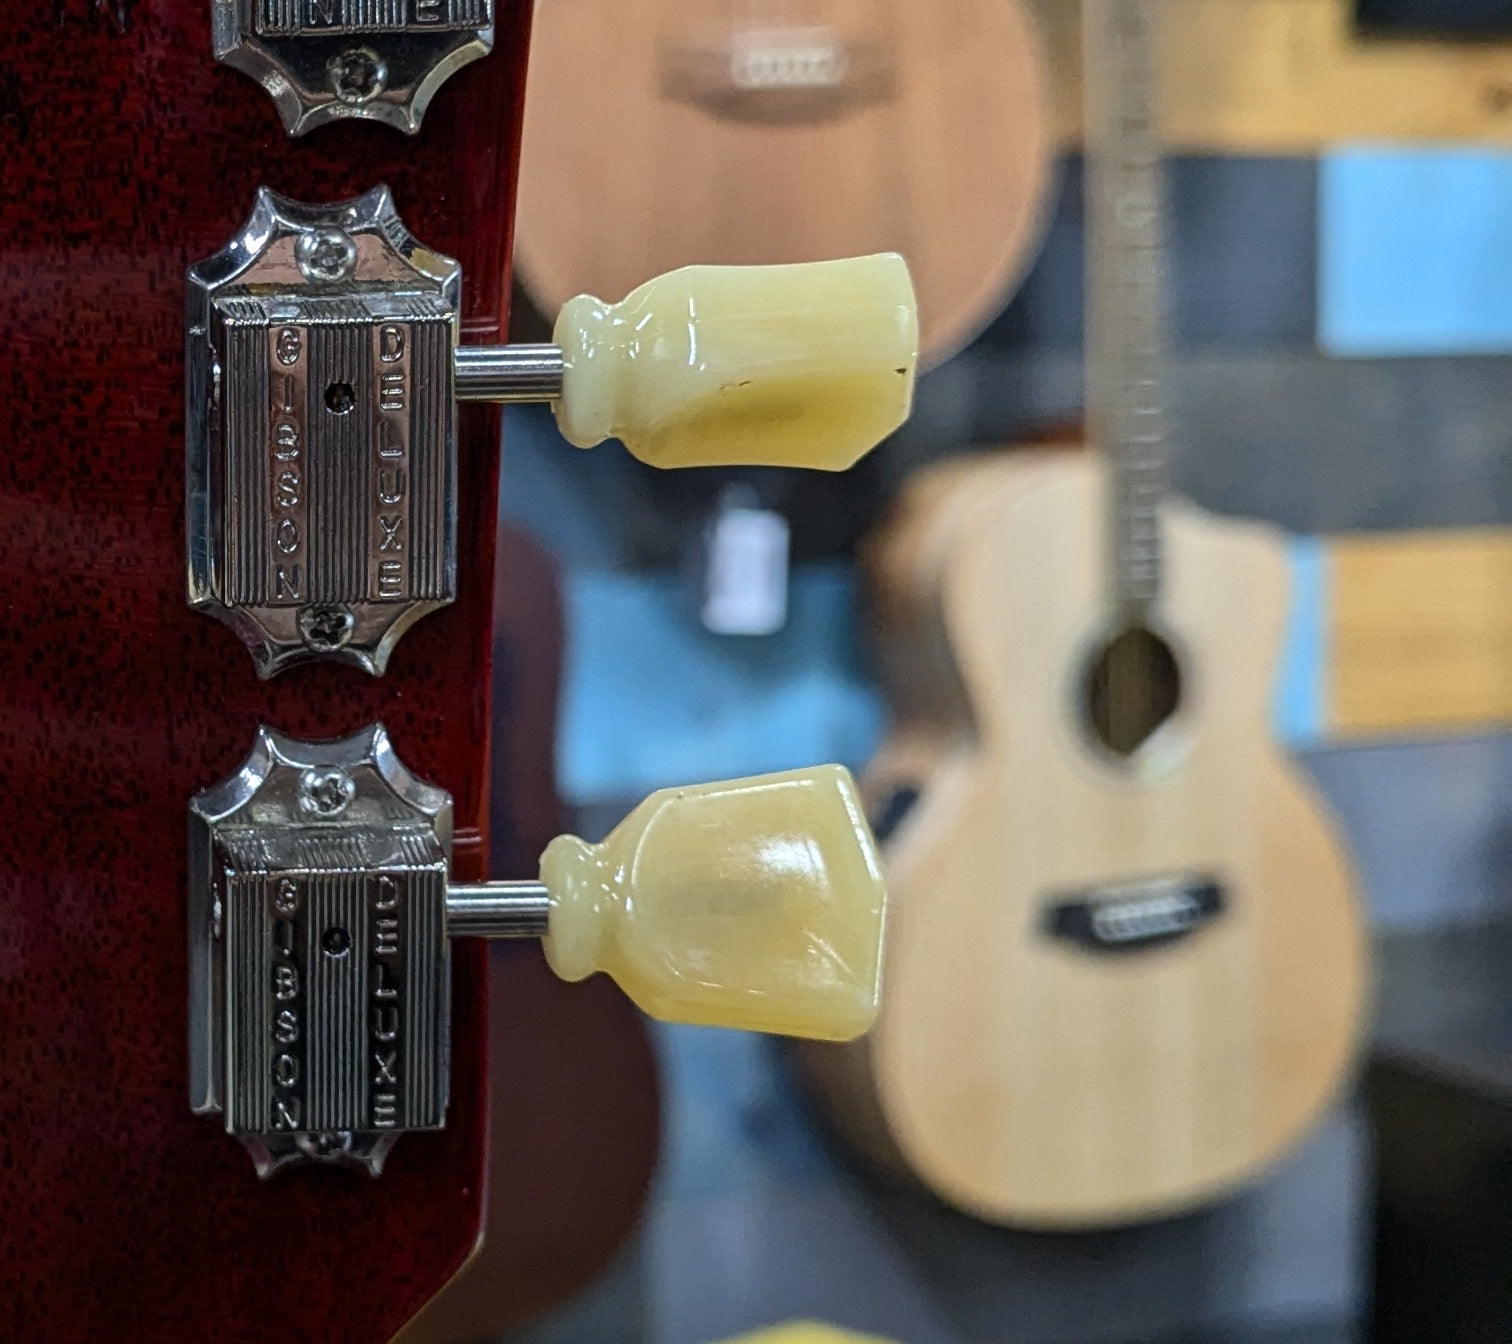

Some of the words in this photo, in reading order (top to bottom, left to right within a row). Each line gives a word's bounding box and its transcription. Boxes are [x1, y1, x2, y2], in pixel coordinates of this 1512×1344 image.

[275, 328, 302, 599] GIBSON
[378, 326, 405, 598] DELUXE
[272, 878, 299, 1131] GIBSON
[374, 874, 399, 1129] DELUXE
